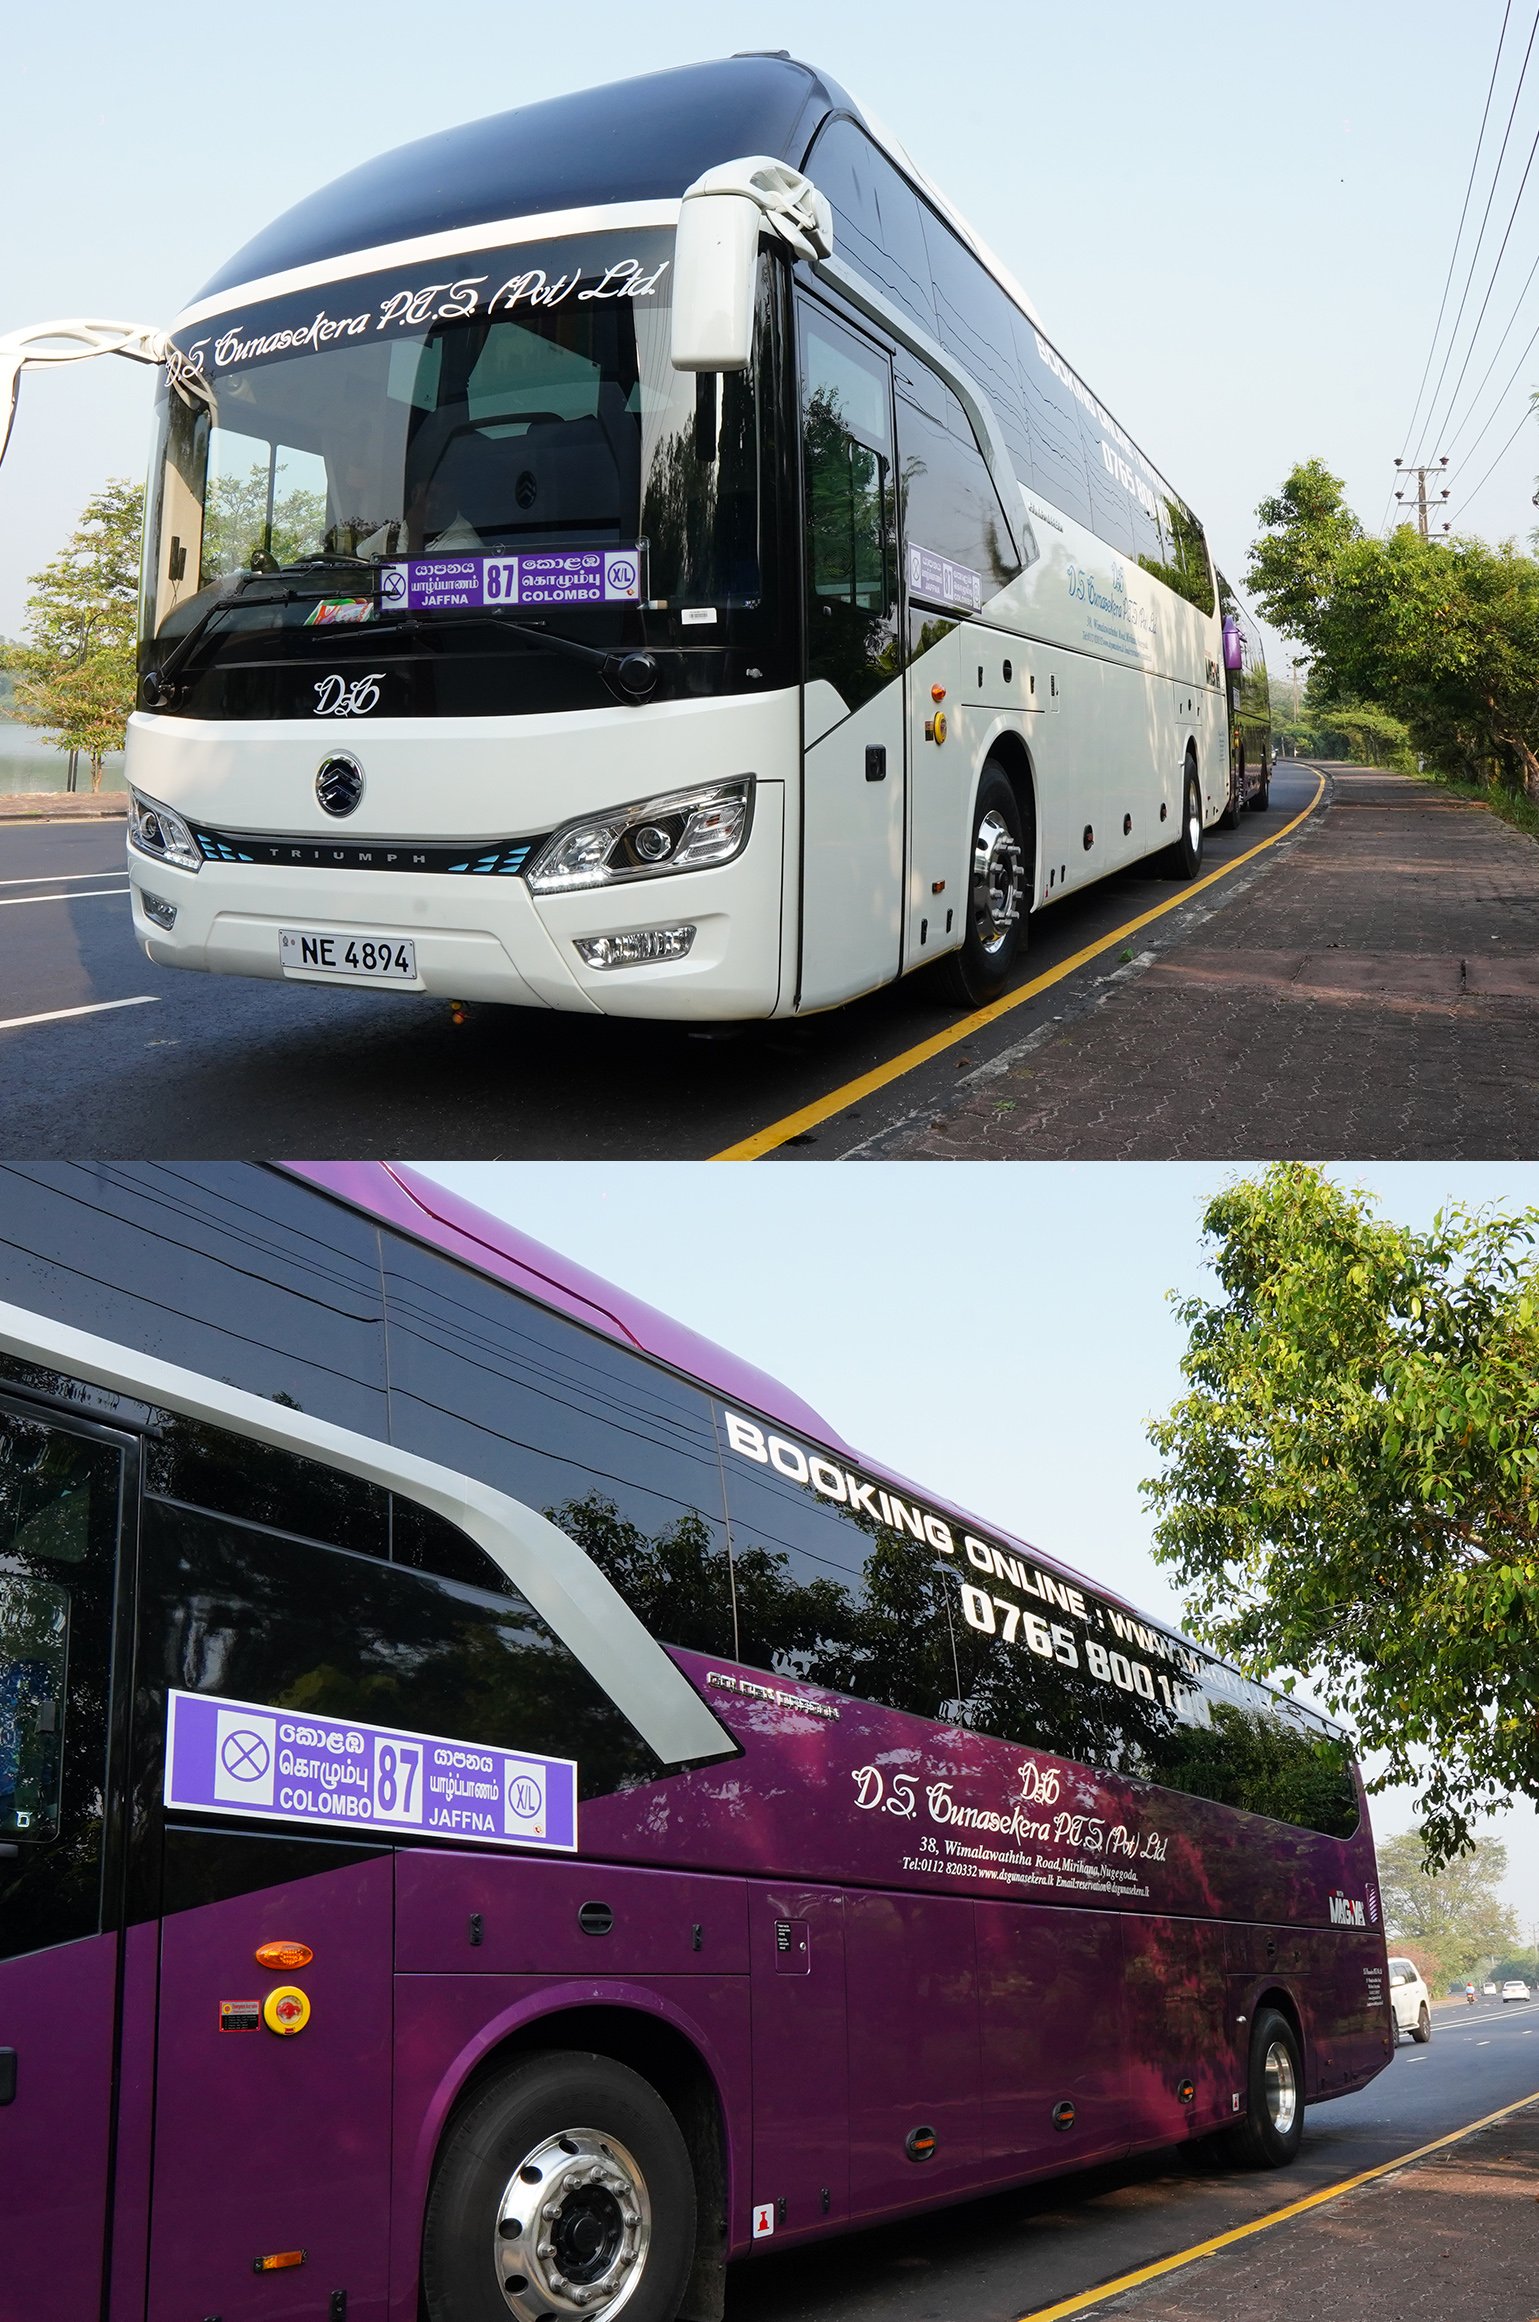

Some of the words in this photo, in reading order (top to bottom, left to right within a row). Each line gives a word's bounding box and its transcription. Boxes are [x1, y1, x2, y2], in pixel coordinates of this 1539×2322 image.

[488, 268, 582, 315] (Pvt)
[1101, 440, 1136, 496] 0765
[487, 564, 514, 599] 87
[522, 589, 600, 601] COLOMBO
[421, 594, 468, 606] JAFFNA
[270, 848, 425, 863] TRIUMPH
[301, 937, 336, 966] NE
[344, 941, 409, 972] 4894
[724, 1410, 954, 1554] BOOKING
[964, 1534, 1088, 1619] ONLINE
[960, 1584, 1079, 1669] 0765
[1085, 1640, 1155, 1700] 800
[279, 1724, 365, 1754] කොළඹ
[279, 1749, 368, 1793] கொழும்பு
[378, 1744, 419, 1813] 87
[280, 1787, 372, 1818] COLOMBO
[429, 1807, 496, 1832] JAFFNA
[919, 1836, 939, 1855] 38,
[944, 1839, 1032, 1866] Wimalawaththa
[1106, 1825, 1141, 1859] (Pvt)
[946, 1862, 978, 1877] 820332
